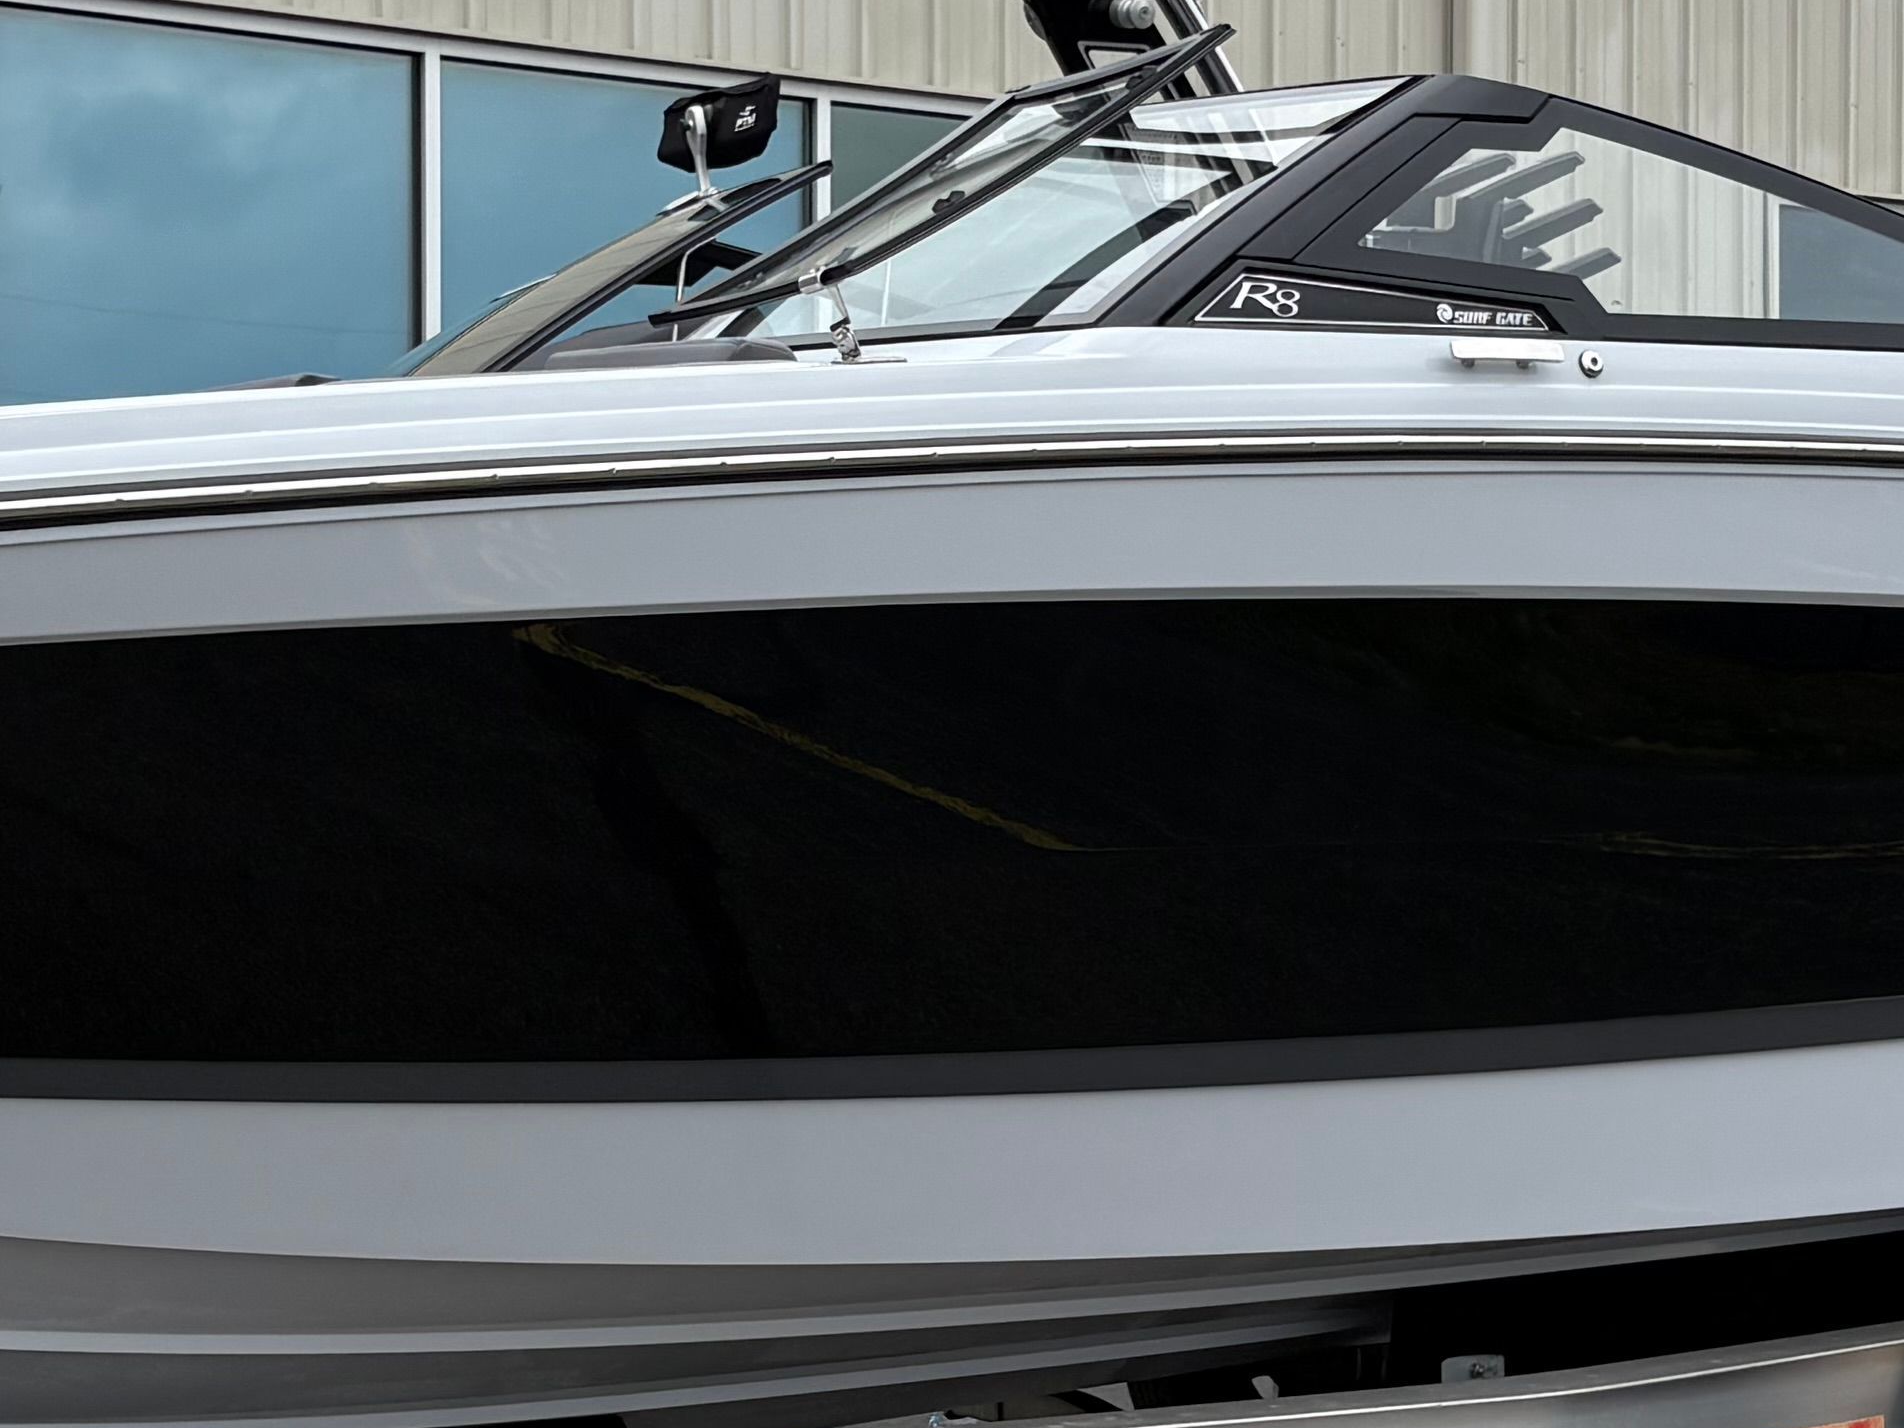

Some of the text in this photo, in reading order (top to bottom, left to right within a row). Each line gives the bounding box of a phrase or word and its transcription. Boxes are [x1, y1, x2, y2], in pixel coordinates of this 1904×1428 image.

[1229, 281, 1301, 318] R8
[1453, 311, 1533, 326] SURF GATE
